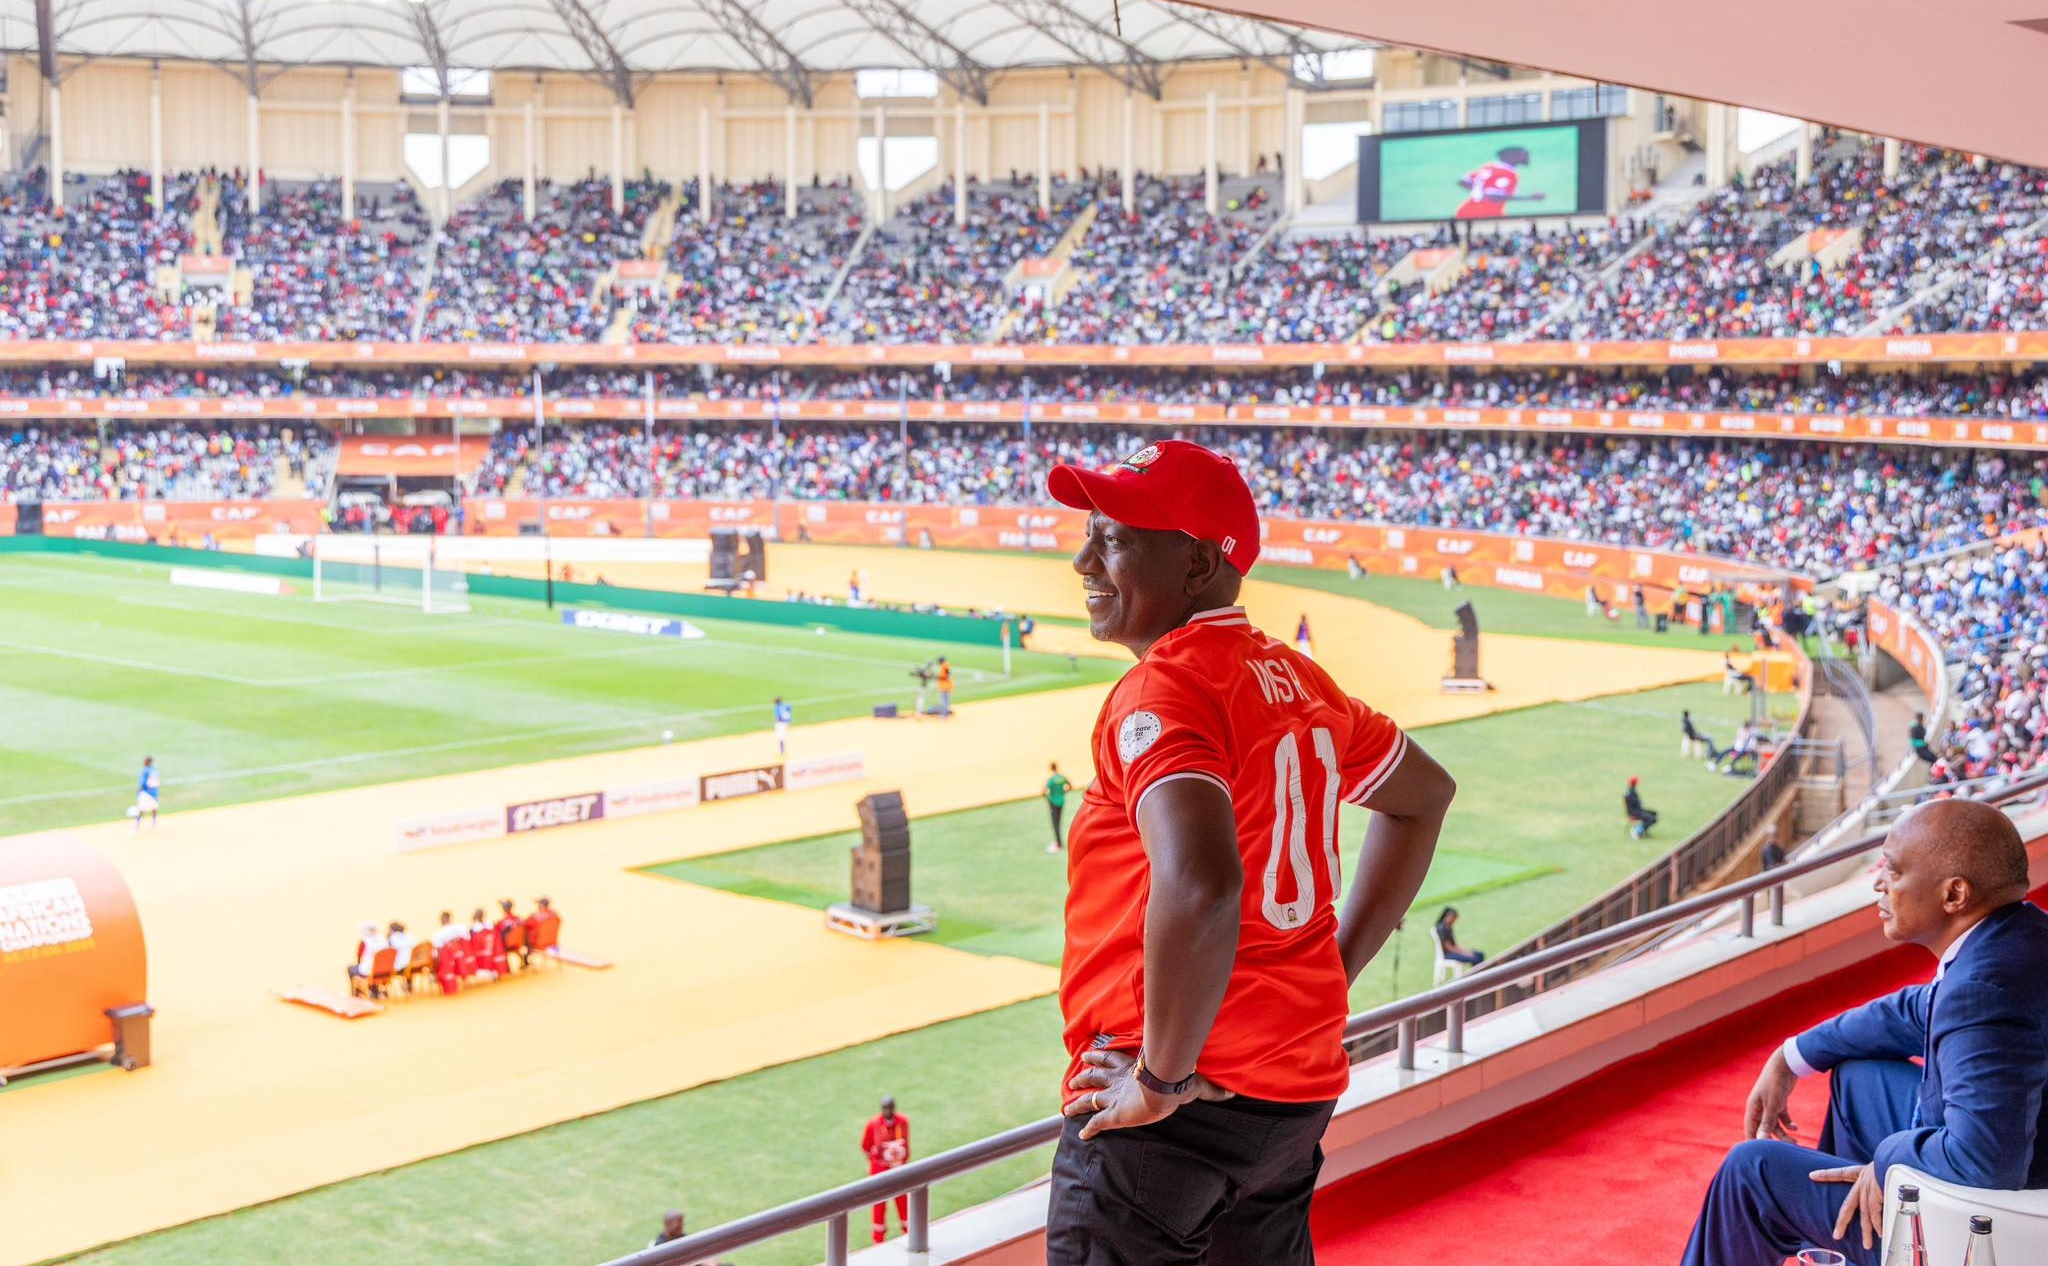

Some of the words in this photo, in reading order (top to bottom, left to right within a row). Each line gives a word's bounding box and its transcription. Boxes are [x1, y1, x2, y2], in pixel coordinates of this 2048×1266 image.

[1303, 527, 1341, 543] CAF
[1221, 535, 1237, 555] 01
[1437, 538, 1471, 554] CAF
[1563, 550, 1597, 568] CAF
[513, 796, 598, 831] 1XBET
[1262, 727, 1341, 930] 01
